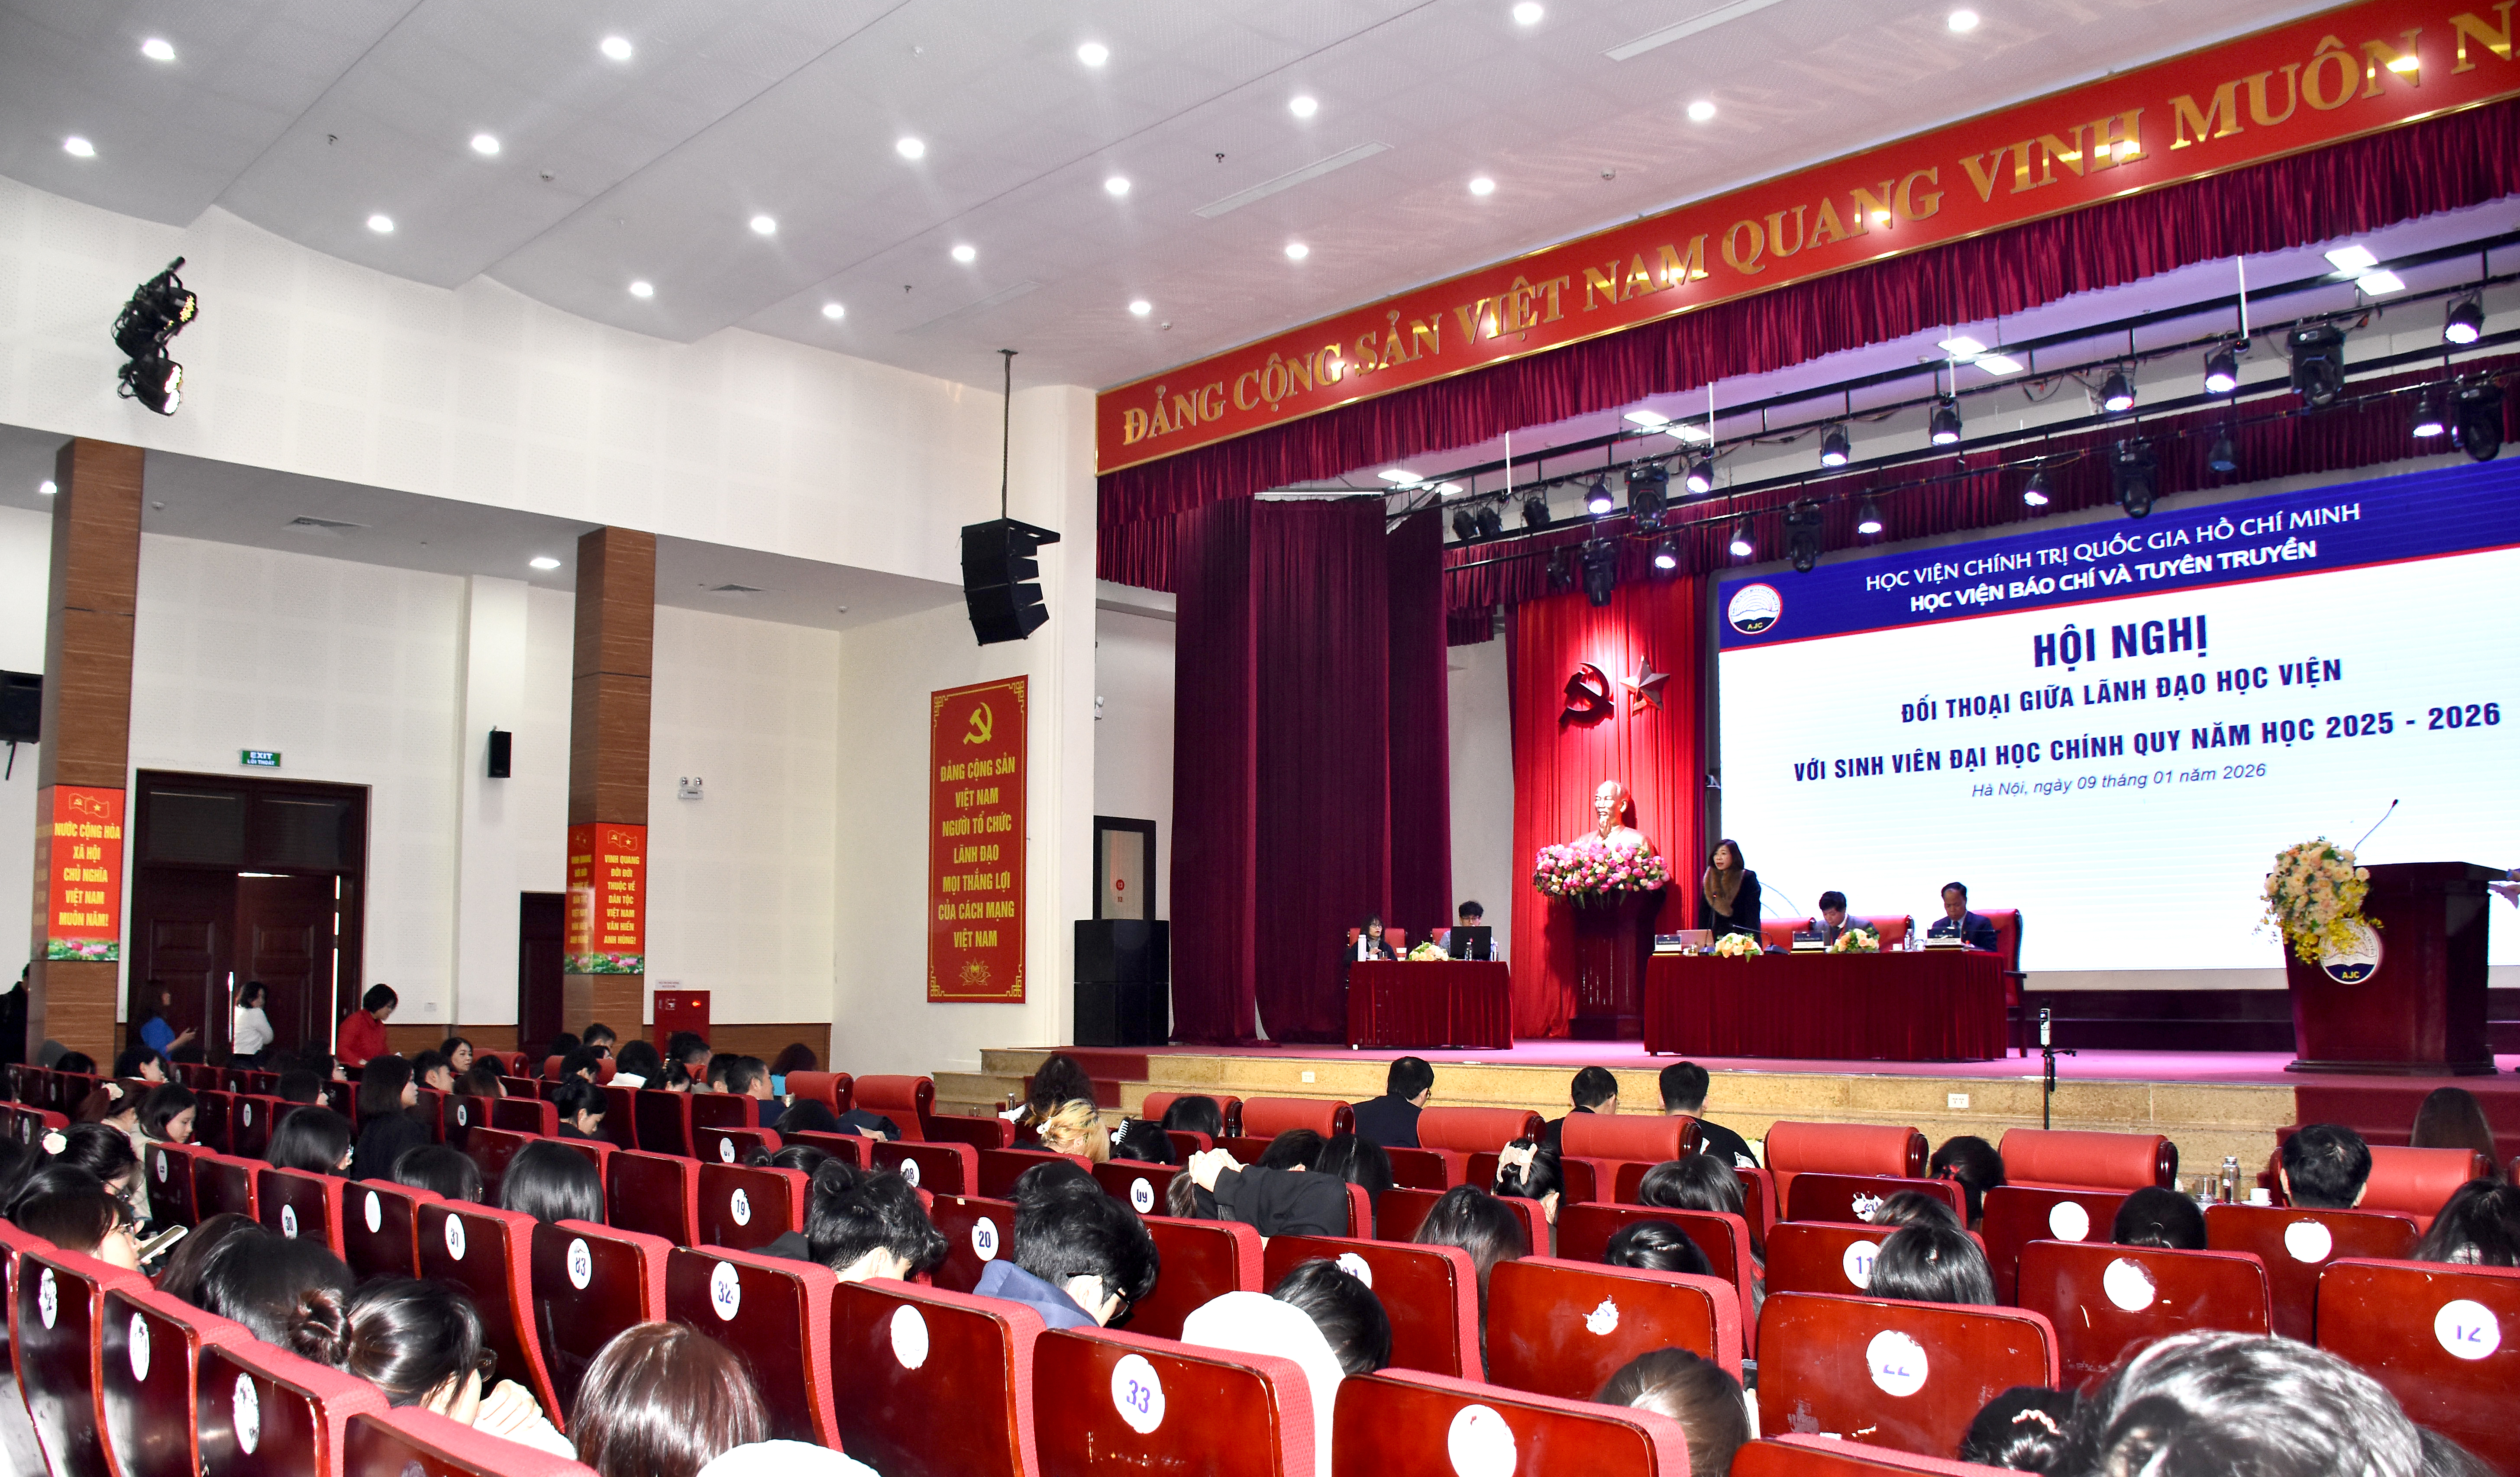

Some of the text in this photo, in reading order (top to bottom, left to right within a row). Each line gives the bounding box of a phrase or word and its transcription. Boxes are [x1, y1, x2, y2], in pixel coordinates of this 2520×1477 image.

[1123, 0, 2520, 445] ĐẢNG CỘNG SẢN VIỆT NAM QUANG VINH MUÔN N
[1866, 503, 2361, 592] HỌC VIỆN CHÍNH TRỊ QUỐC GIA HỒ CHÍ MINH
[1910, 536, 2317, 613] HỌC VIỆN BÁO CHÍ VÀ TUYÊN TRUYỀN
[1747, 622, 1763, 631] AJC
[2033, 614, 2207, 672] HỘI NGHỊ
[1901, 657, 2342, 723] ĐỐI THOẠI GIỮA LÃNH ĐẠO HỌC VIỆN
[1794, 757, 1826, 782] VỚI
[1834, 755, 1884, 779] SINH
[1892, 748, 1941, 774] VIÊN
[1949, 747, 1986, 773] ĐẠI
[1995, 742, 2040, 769] HỌC
[2050, 733, 2124, 761] CHÍNH
[2133, 729, 2180, 756] QUY
[2191, 722, 2251, 750] NĂM
[2261, 718, 2314, 748] HỌC
[2326, 711, 2394, 739] 2025
[2427, 702, 2501, 731] 2026
[940, 751, 1015, 782] ĐẢNG CỘNG SẢN
[1971, 763, 2267, 797] Hà Nội, ngày 09 tháng 01 năm 2026
[955, 787, 998, 811] VIỆT NAM
[79, 821, 103, 840] CỘNG
[942, 810, 1012, 837] NGƯỜI TỔ CHỨC
[73, 843, 101, 863] XÃ HỘI
[953, 844, 999, 865] LÃNH ĐẠO
[63, 864, 81, 882] CHỦ
[82, 866, 109, 883] NGHĨA
[943, 867, 1011, 896] MỌI THẮNG LỢI
[65, 887, 84, 906] VIỆT
[84, 890, 104, 904] NAM
[622, 894, 634, 906] TỘC
[58, 909, 84, 926] MUÔN
[86, 910, 109, 927] NĂM!
[607, 907, 620, 919] VIỆT
[938, 898, 1015, 922] CỦA CÁCH MẠNG
[953, 928, 998, 951] VIỆT NAM
[2342, 971, 2360, 979] AJC
[737, 1199, 745, 1216] 19
[285, 1215, 294, 1232] 30
[450, 1227, 459, 1248] 31
[978, 1230, 992, 1249] 20
[1126, 1378, 1151, 1414] 33
